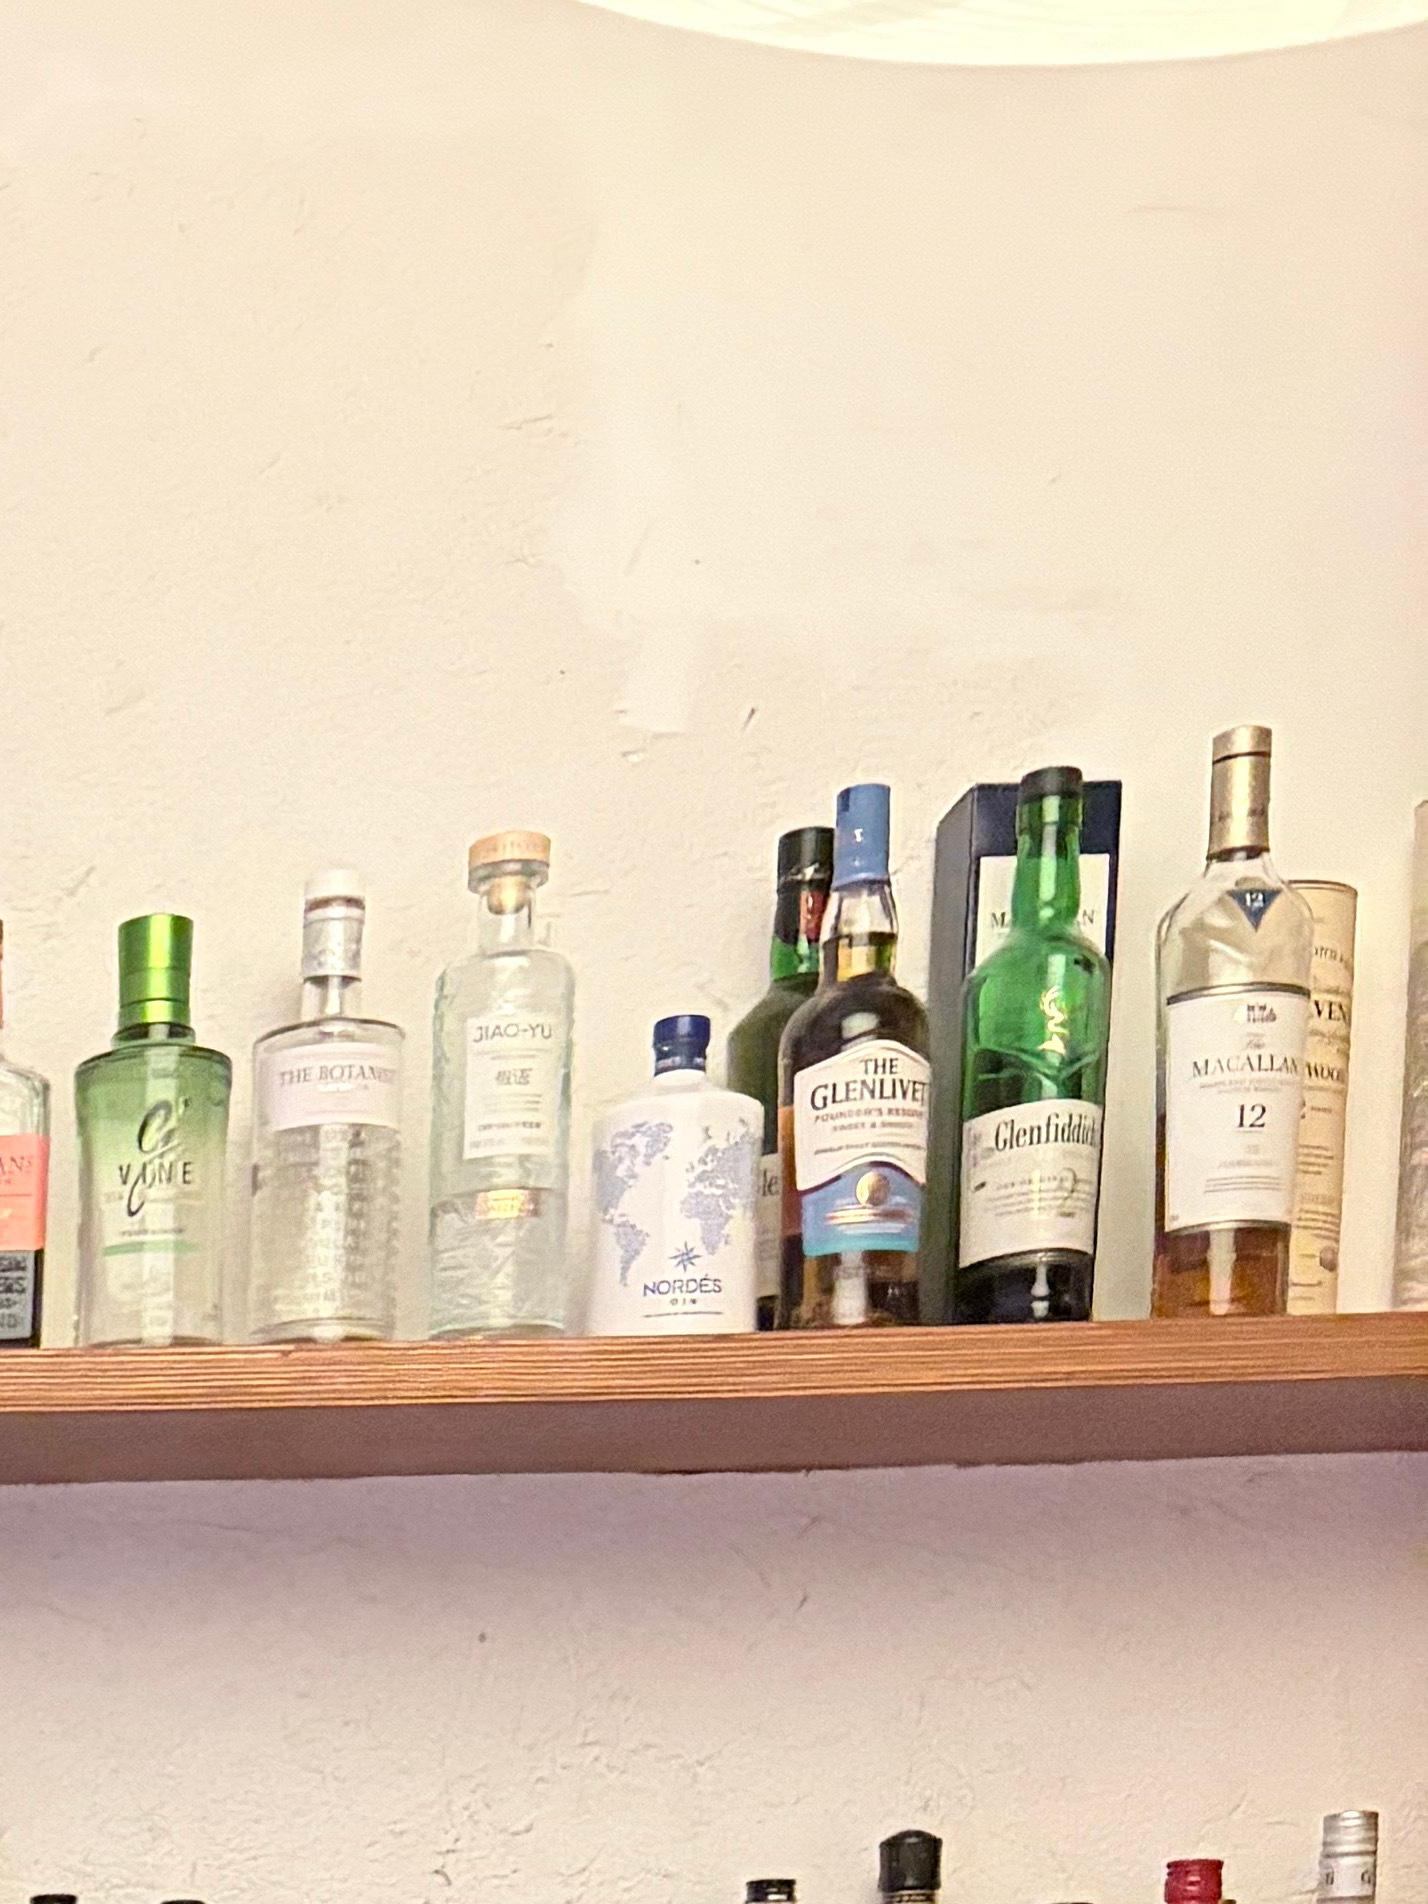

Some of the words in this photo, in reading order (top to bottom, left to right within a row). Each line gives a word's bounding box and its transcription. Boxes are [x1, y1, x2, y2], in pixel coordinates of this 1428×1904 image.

[472, 1022, 553, 1044] JIAO-YU
[278, 1065, 313, 1086] THE
[859, 1057, 899, 1075] THE
[1191, 1056, 1300, 1080] MACALLAN
[810, 1078, 929, 1112] GLENLIVET
[1235, 1103, 1267, 1130] 12
[642, 1273, 723, 1297] NORDÉS
